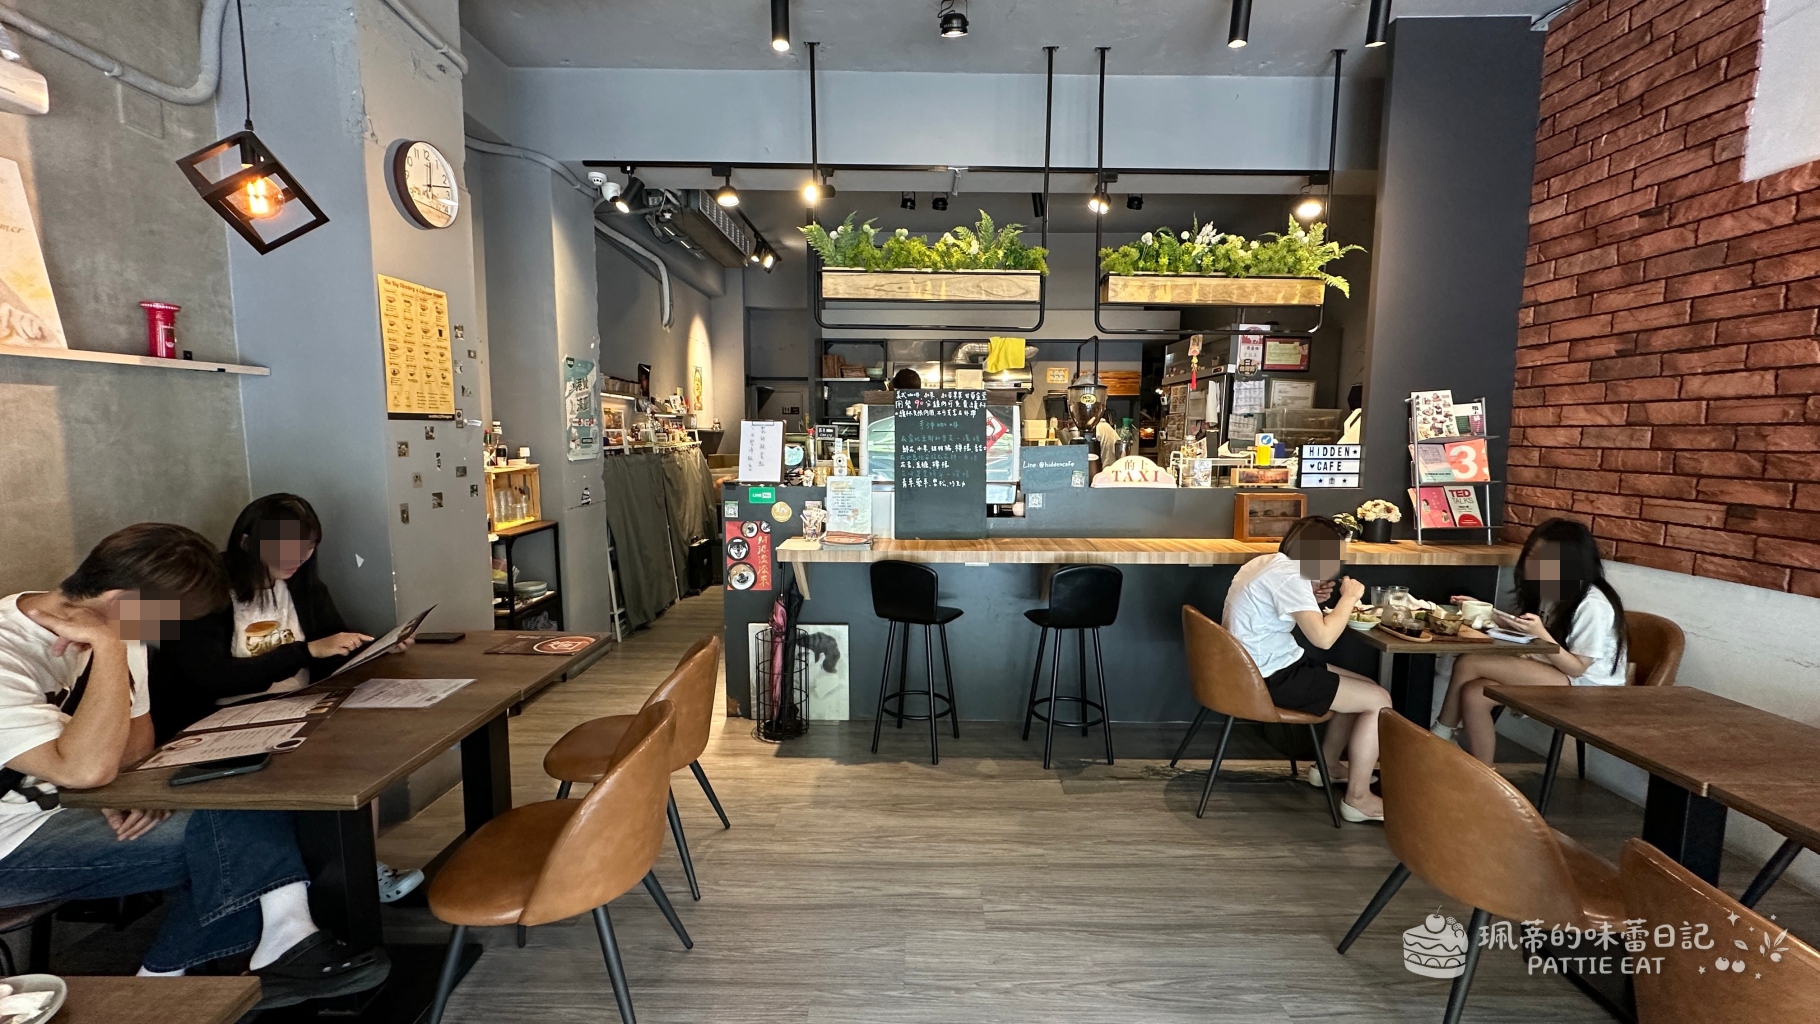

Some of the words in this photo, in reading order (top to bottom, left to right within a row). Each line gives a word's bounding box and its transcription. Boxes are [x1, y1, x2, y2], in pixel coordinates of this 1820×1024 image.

[423, 149, 430, 161] 12
[442, 174, 448, 185] 2
[1309, 446, 1350, 457] HIDDEN
[1317, 461, 1342, 471] CAFE
[1112, 470, 1160, 482] TAXI
[1448, 489, 1471, 498] TED
